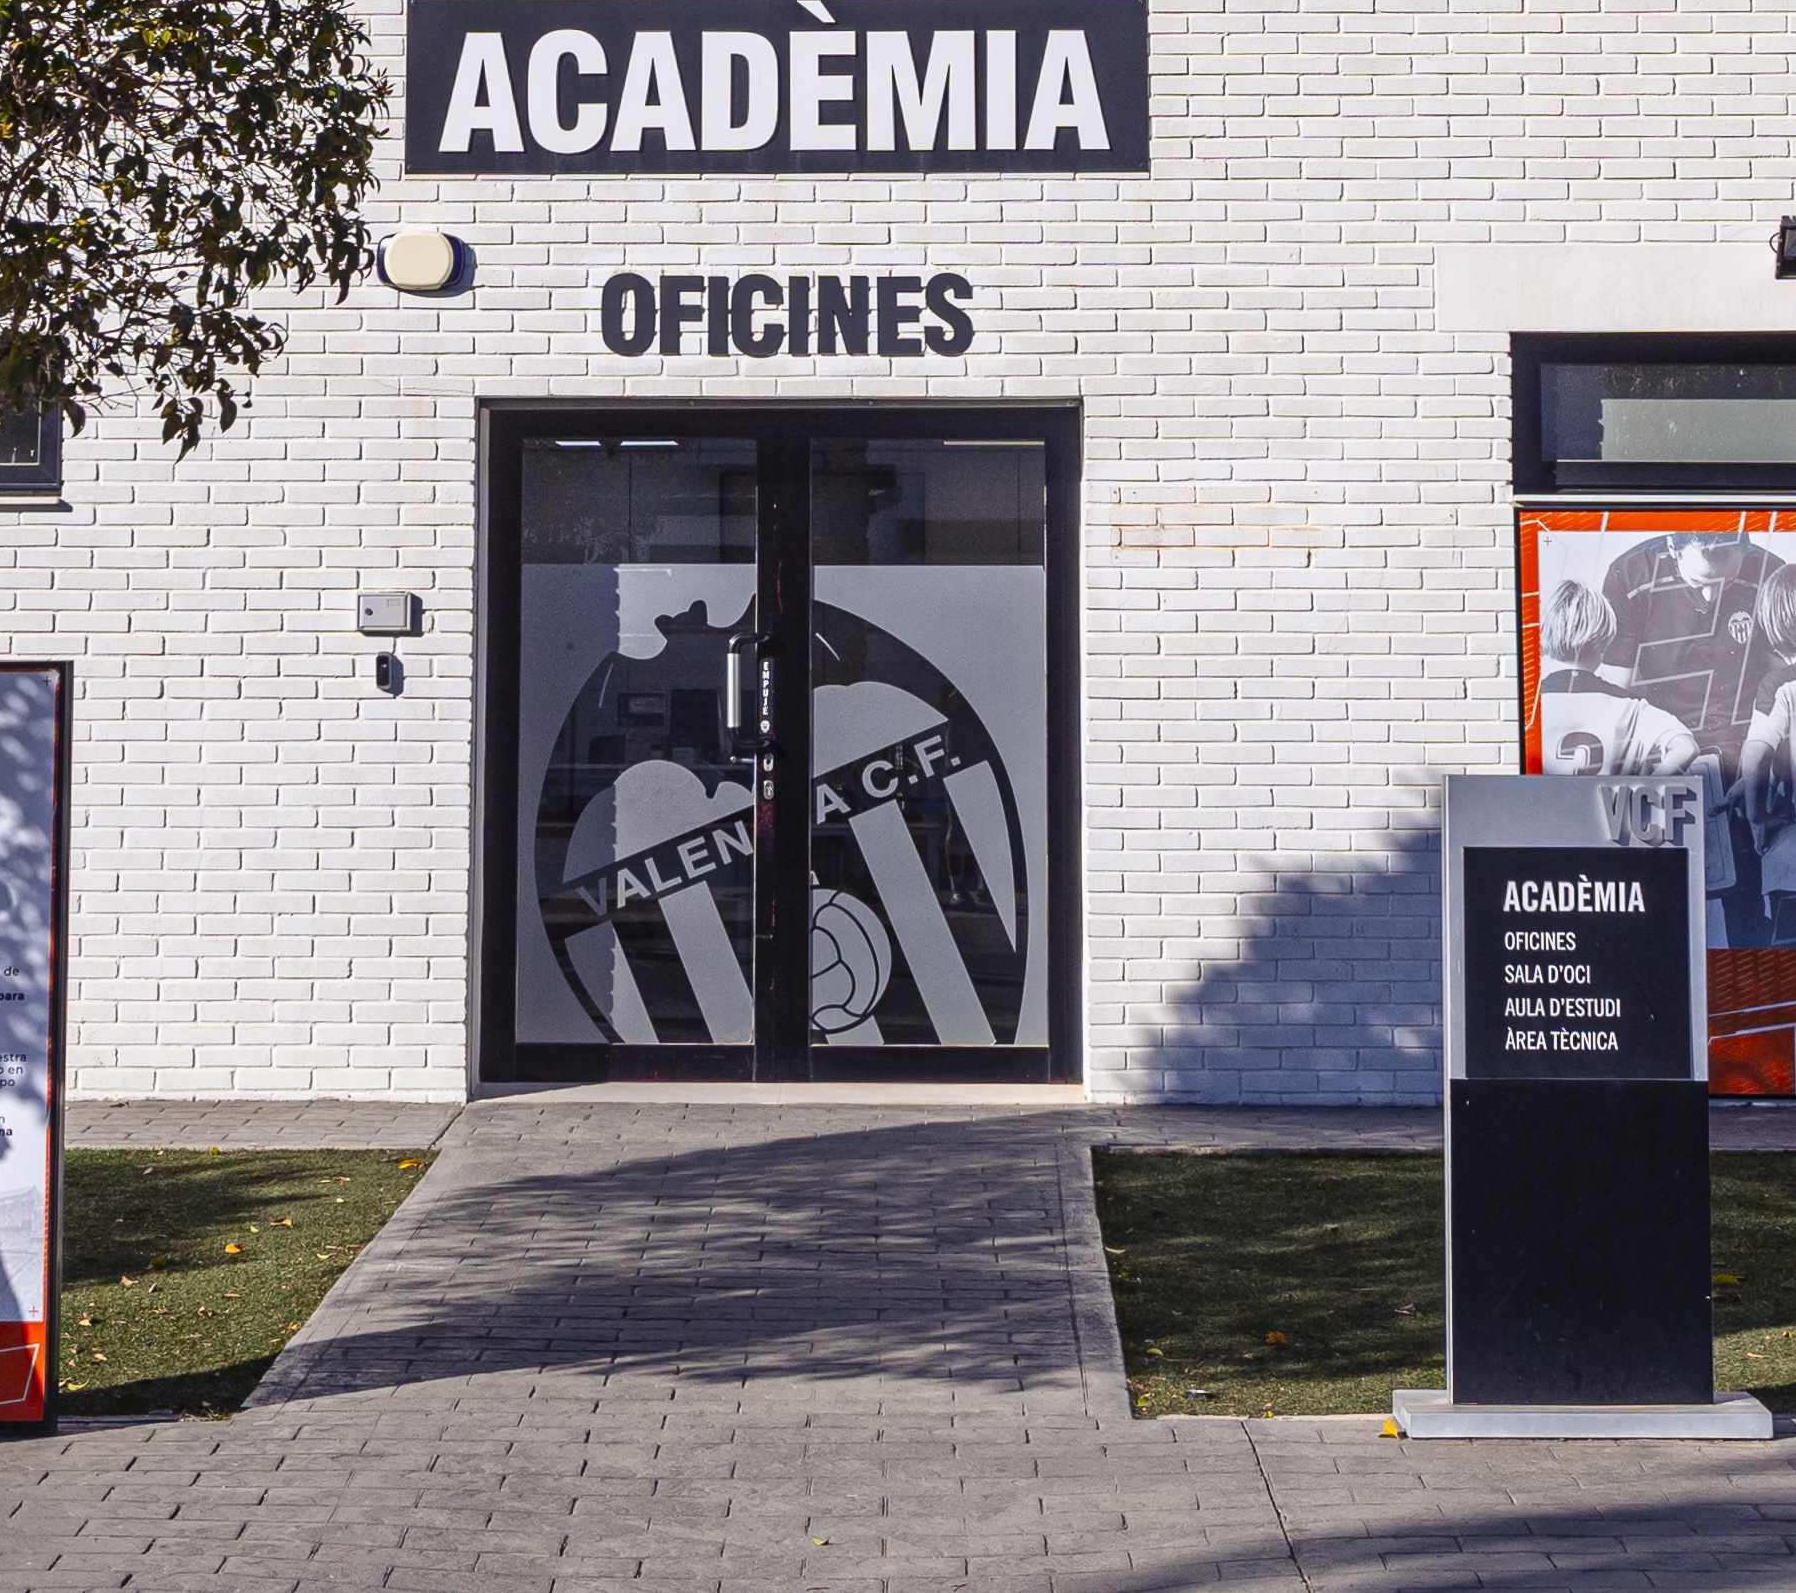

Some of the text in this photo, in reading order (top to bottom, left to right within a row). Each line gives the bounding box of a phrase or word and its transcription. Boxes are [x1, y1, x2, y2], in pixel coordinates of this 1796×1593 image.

[438, 0, 1112, 155] ACADÈMIA
[602, 272, 976, 359] OFICINES
[861, 735, 961, 798] C.F.
[1601, 785, 1695, 844] VCF
[1503, 874, 1645, 912] ACADÈMIA
[1505, 932, 1576, 951] OFICINES
[4, 966, 19, 976] de
[1505, 964, 1544, 983] SALA
[1505, 998, 1545, 1017] AULA
[1505, 1026, 1618, 1050] ÀREA TÈCNICA
